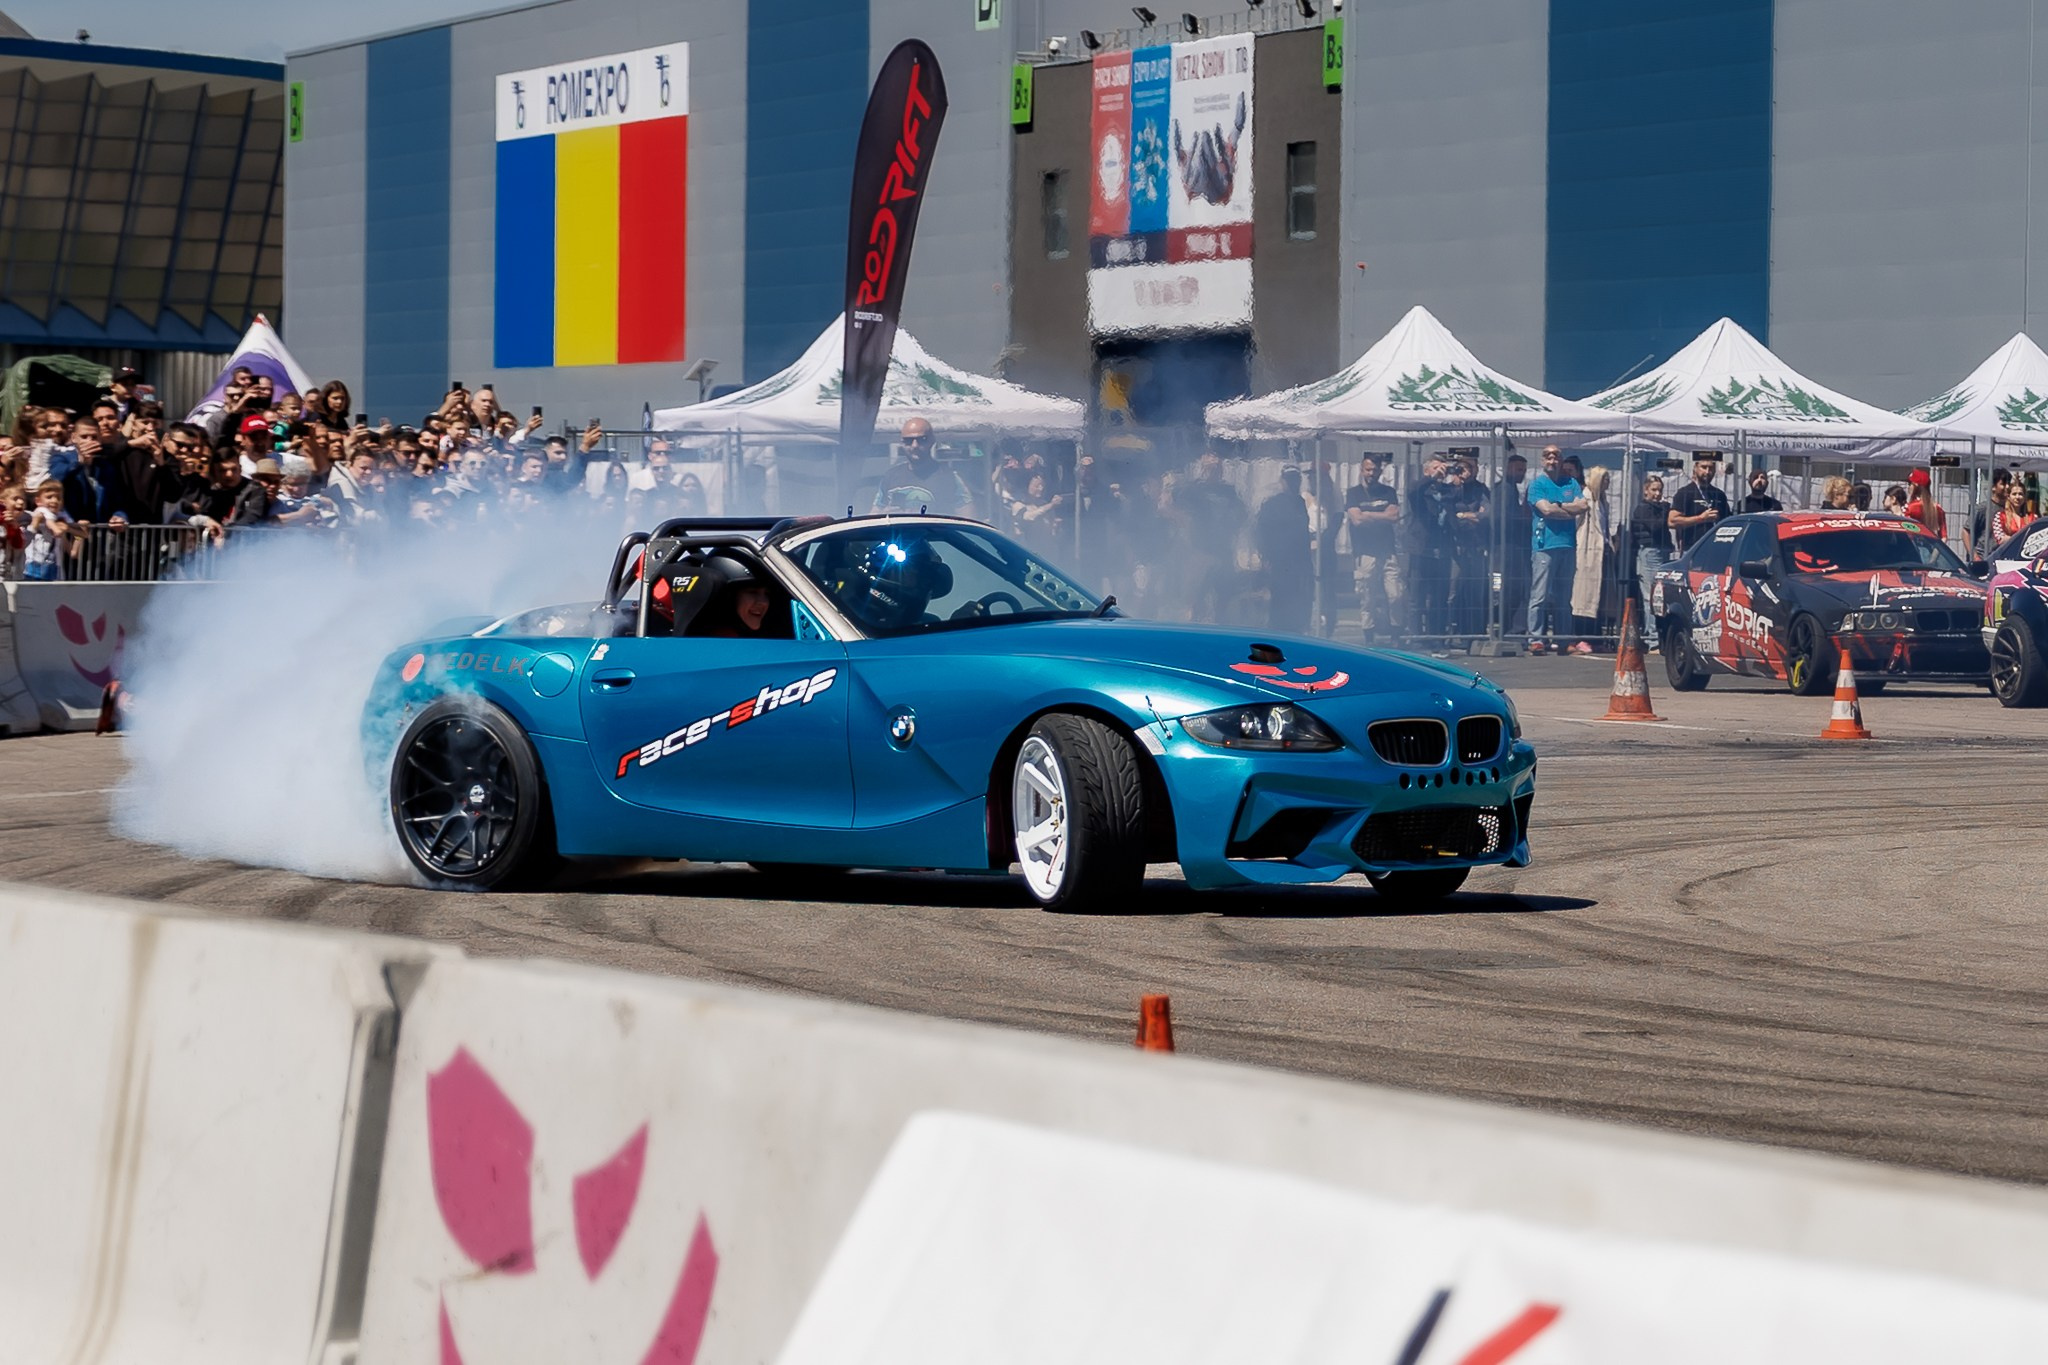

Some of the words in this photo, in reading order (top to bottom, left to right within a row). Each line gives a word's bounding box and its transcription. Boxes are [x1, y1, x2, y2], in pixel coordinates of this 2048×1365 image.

[1326, 34, 1343, 69] B3
[546, 62, 630, 125] ROMEXPO
[1013, 78, 1029, 110] B3
[1387, 402, 1553, 413] CARAIMAN
[1701, 413, 1863, 425] CARAIMAN
[615, 667, 838, 780] race-shop
